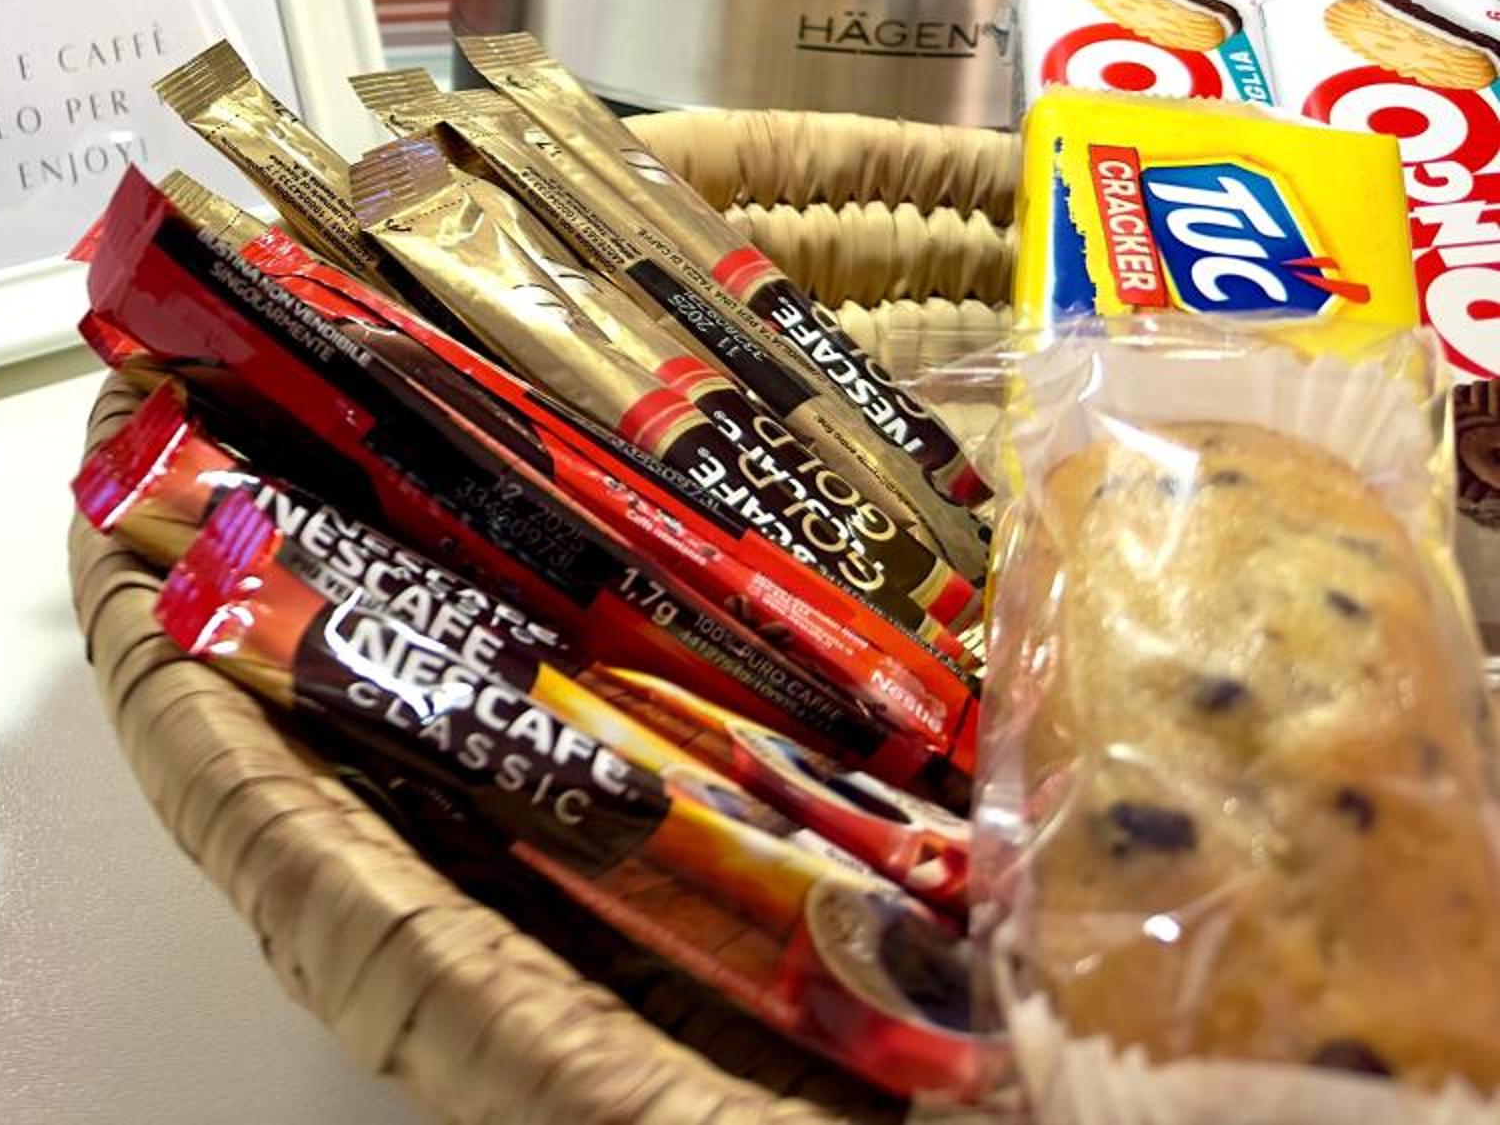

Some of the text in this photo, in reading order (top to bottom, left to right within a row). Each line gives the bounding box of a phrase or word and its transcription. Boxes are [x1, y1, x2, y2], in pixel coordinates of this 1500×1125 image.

[797, 10, 981, 51] HÄGEN
[16, 52, 34, 82] E
[65, 89, 130, 125] PER
[18, 137, 149, 191] ENJOY!
[1097, 161, 1160, 293] CRACKER
[195, 226, 372, 367] BUSTINA NON VENDIBILE
[209, 260, 335, 363] SINGOLARMENTE
[668, 292, 715, 331] 2025
[753, 415, 898, 542] GOLD
[622, 566, 679, 628] 1,7g
[736, 645, 788, 686] PURO
[347, 681, 591, 826] CLASSIC
